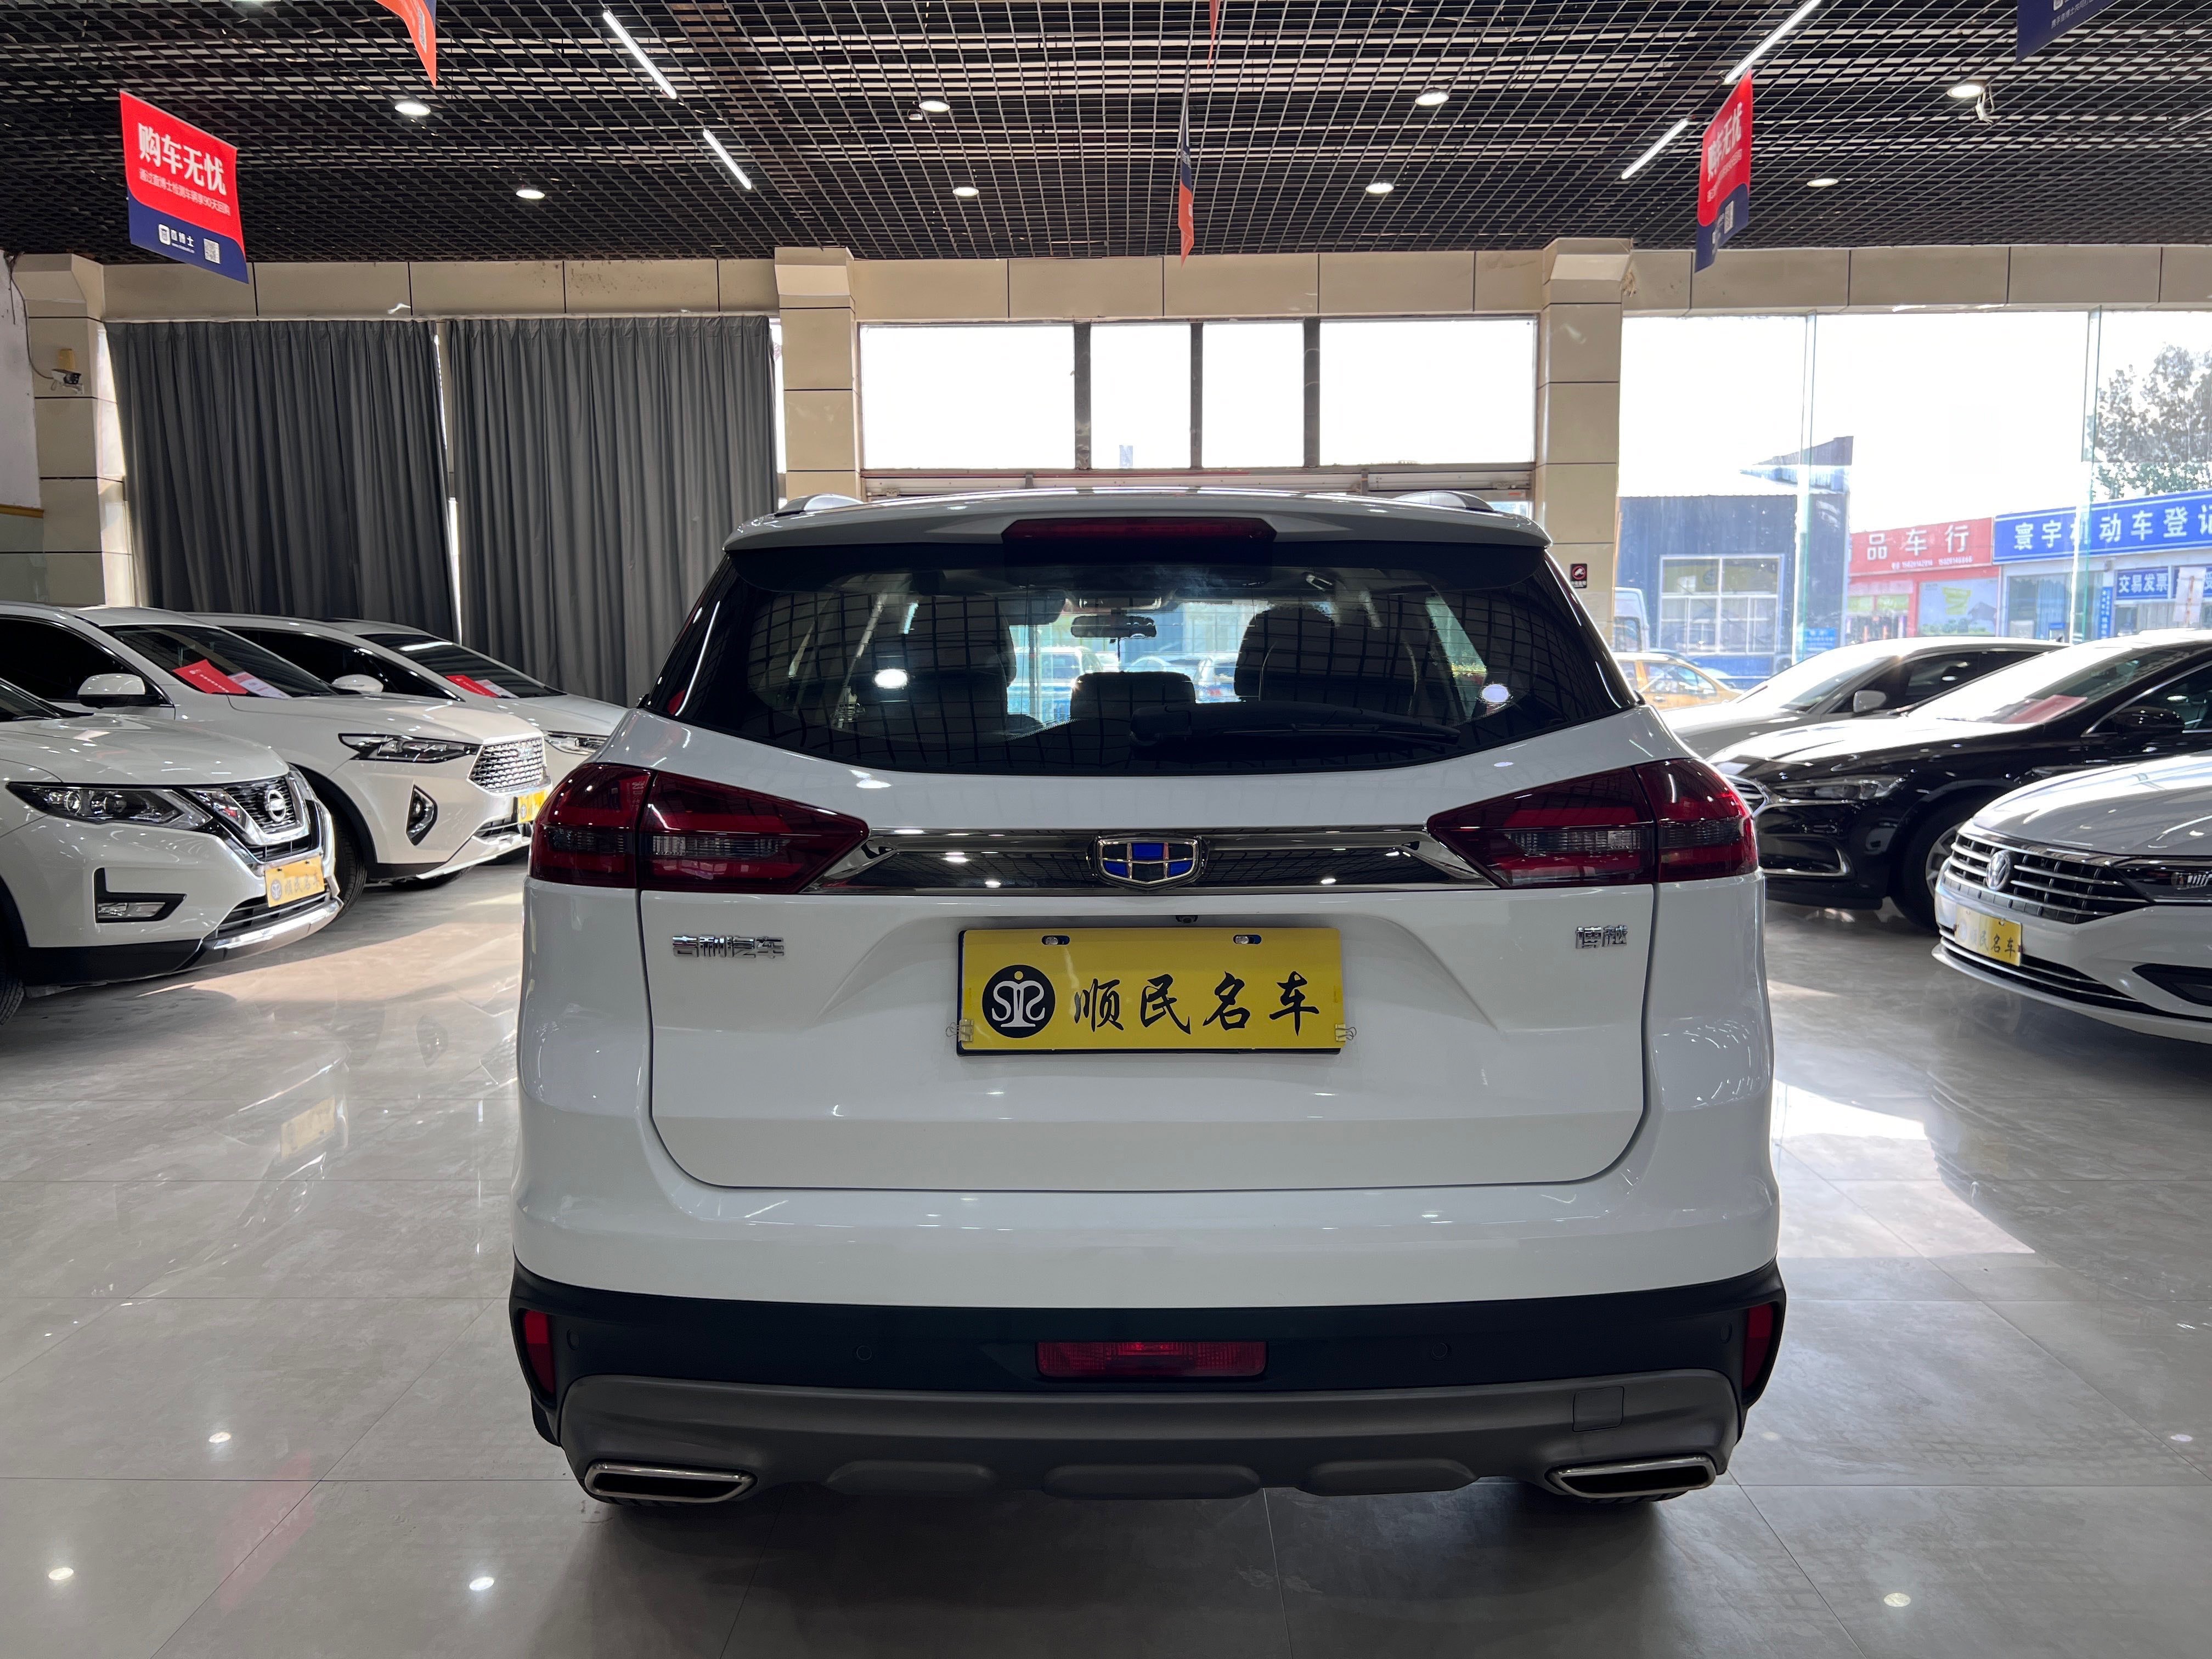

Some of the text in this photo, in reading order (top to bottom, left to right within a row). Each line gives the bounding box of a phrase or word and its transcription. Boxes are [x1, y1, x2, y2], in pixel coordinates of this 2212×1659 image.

[138, 122, 227, 196] 购车无忧
[1848, 524, 1969, 562] 品车行
[2118, 573, 2168, 594] 交易发票
[1074, 970, 1320, 1036] 顺民名车
